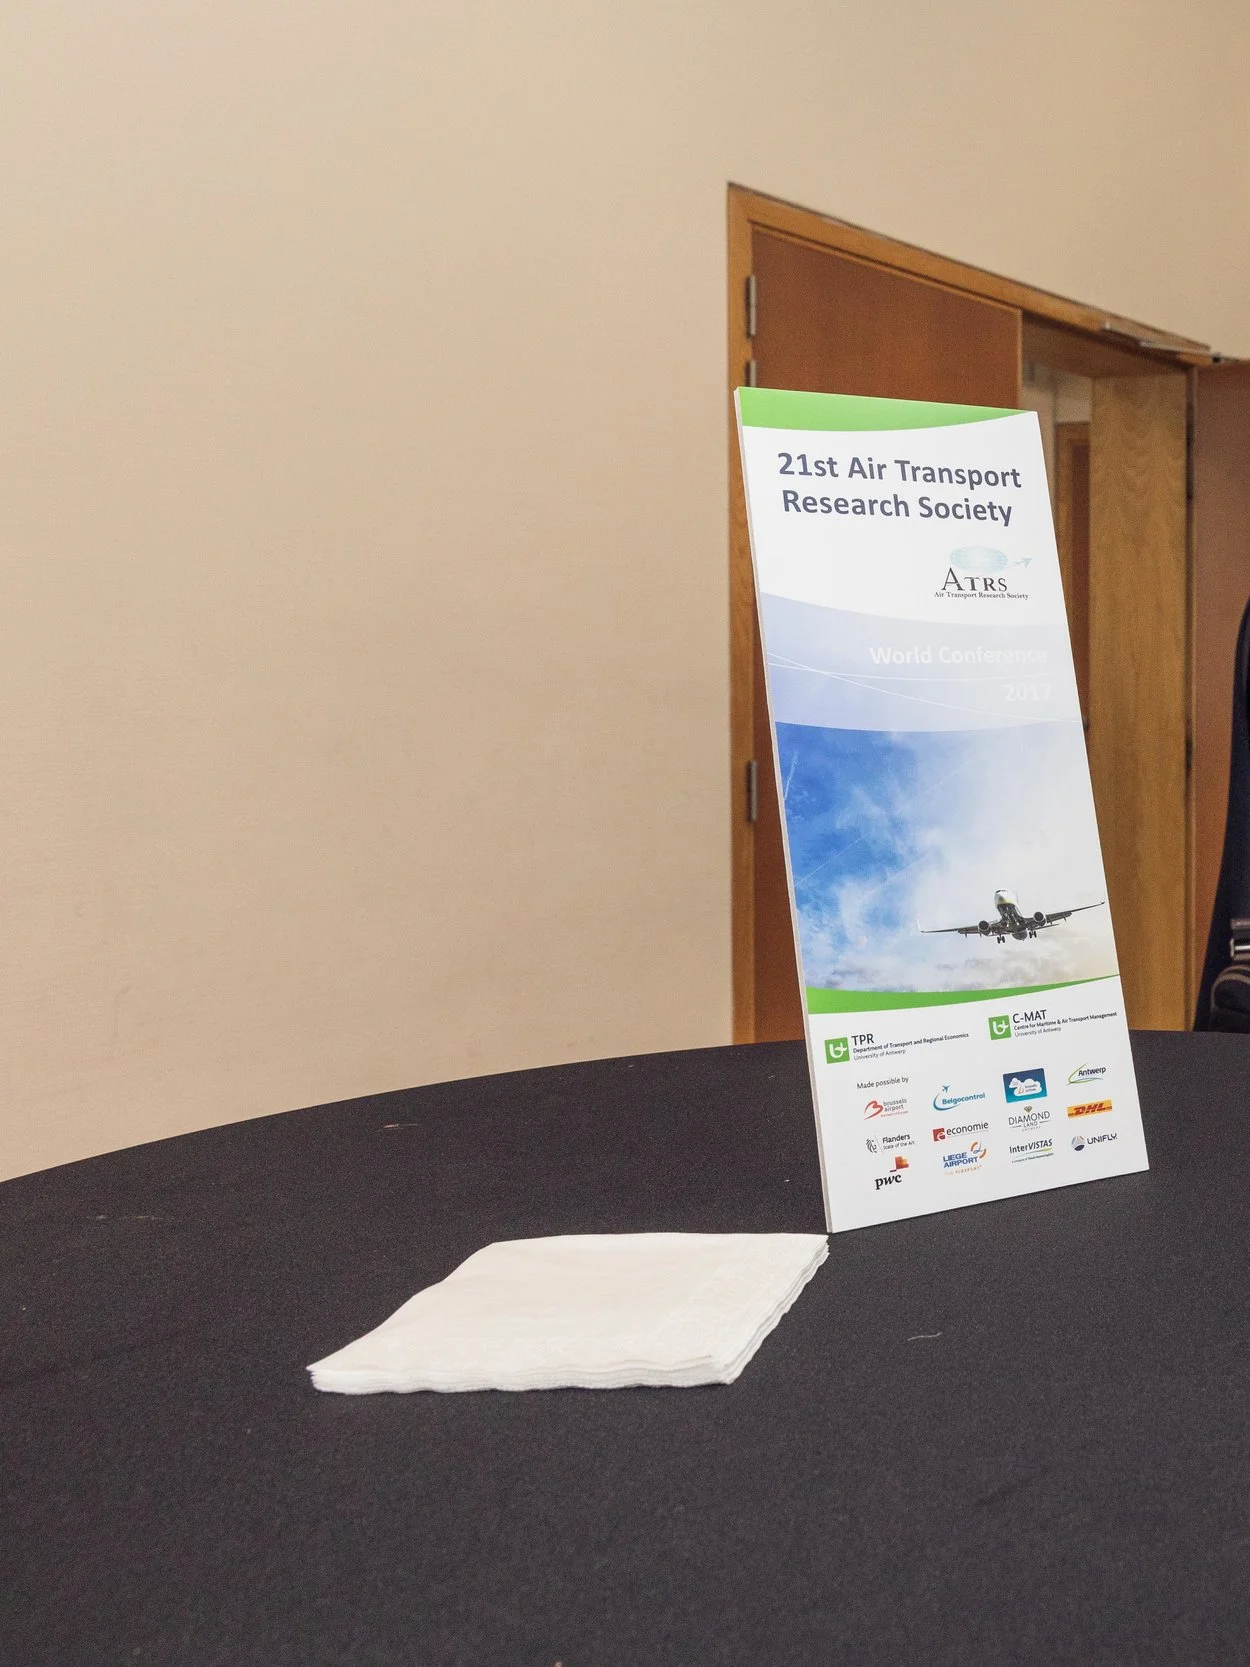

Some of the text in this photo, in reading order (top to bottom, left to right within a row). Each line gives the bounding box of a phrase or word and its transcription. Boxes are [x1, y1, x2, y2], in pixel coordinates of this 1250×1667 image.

[777, 451, 1022, 490] 21st Air Transport
[782, 489, 1013, 526] Research Society
[941, 566, 1008, 592] ATRS
[869, 645, 1048, 665] World Conference
[1004, 683, 1051, 702] 2017
[1012, 1009, 1047, 1024] C-MAT
[1068, 1015, 1090, 1023] Transport
[851, 1033, 875, 1046] TPR
[853, 1045, 882, 1053] Department
[923, 1036, 944, 1044] Regional
[854, 1053, 879, 1061] University
[1078, 1066, 1107, 1077] Antwerp
[875, 1078, 900, 1087] possible
[883, 1098, 907, 1107] brussels
[942, 1092, 986, 1105] Belgocontrol
[884, 1104, 904, 1112] airport
[1073, 1102, 1105, 1116] DHL
[1008, 1110, 1051, 1126] DIAMOND
[946, 1121, 989, 1135] economie
[882, 1134, 911, 1144] Flanders
[1009, 1138, 1053, 1154] InterVISTAS
[943, 1152, 967, 1162] LIEGE
[943, 1156, 979, 1169] AIRPORT
[874, 1174, 903, 1190] pwc
